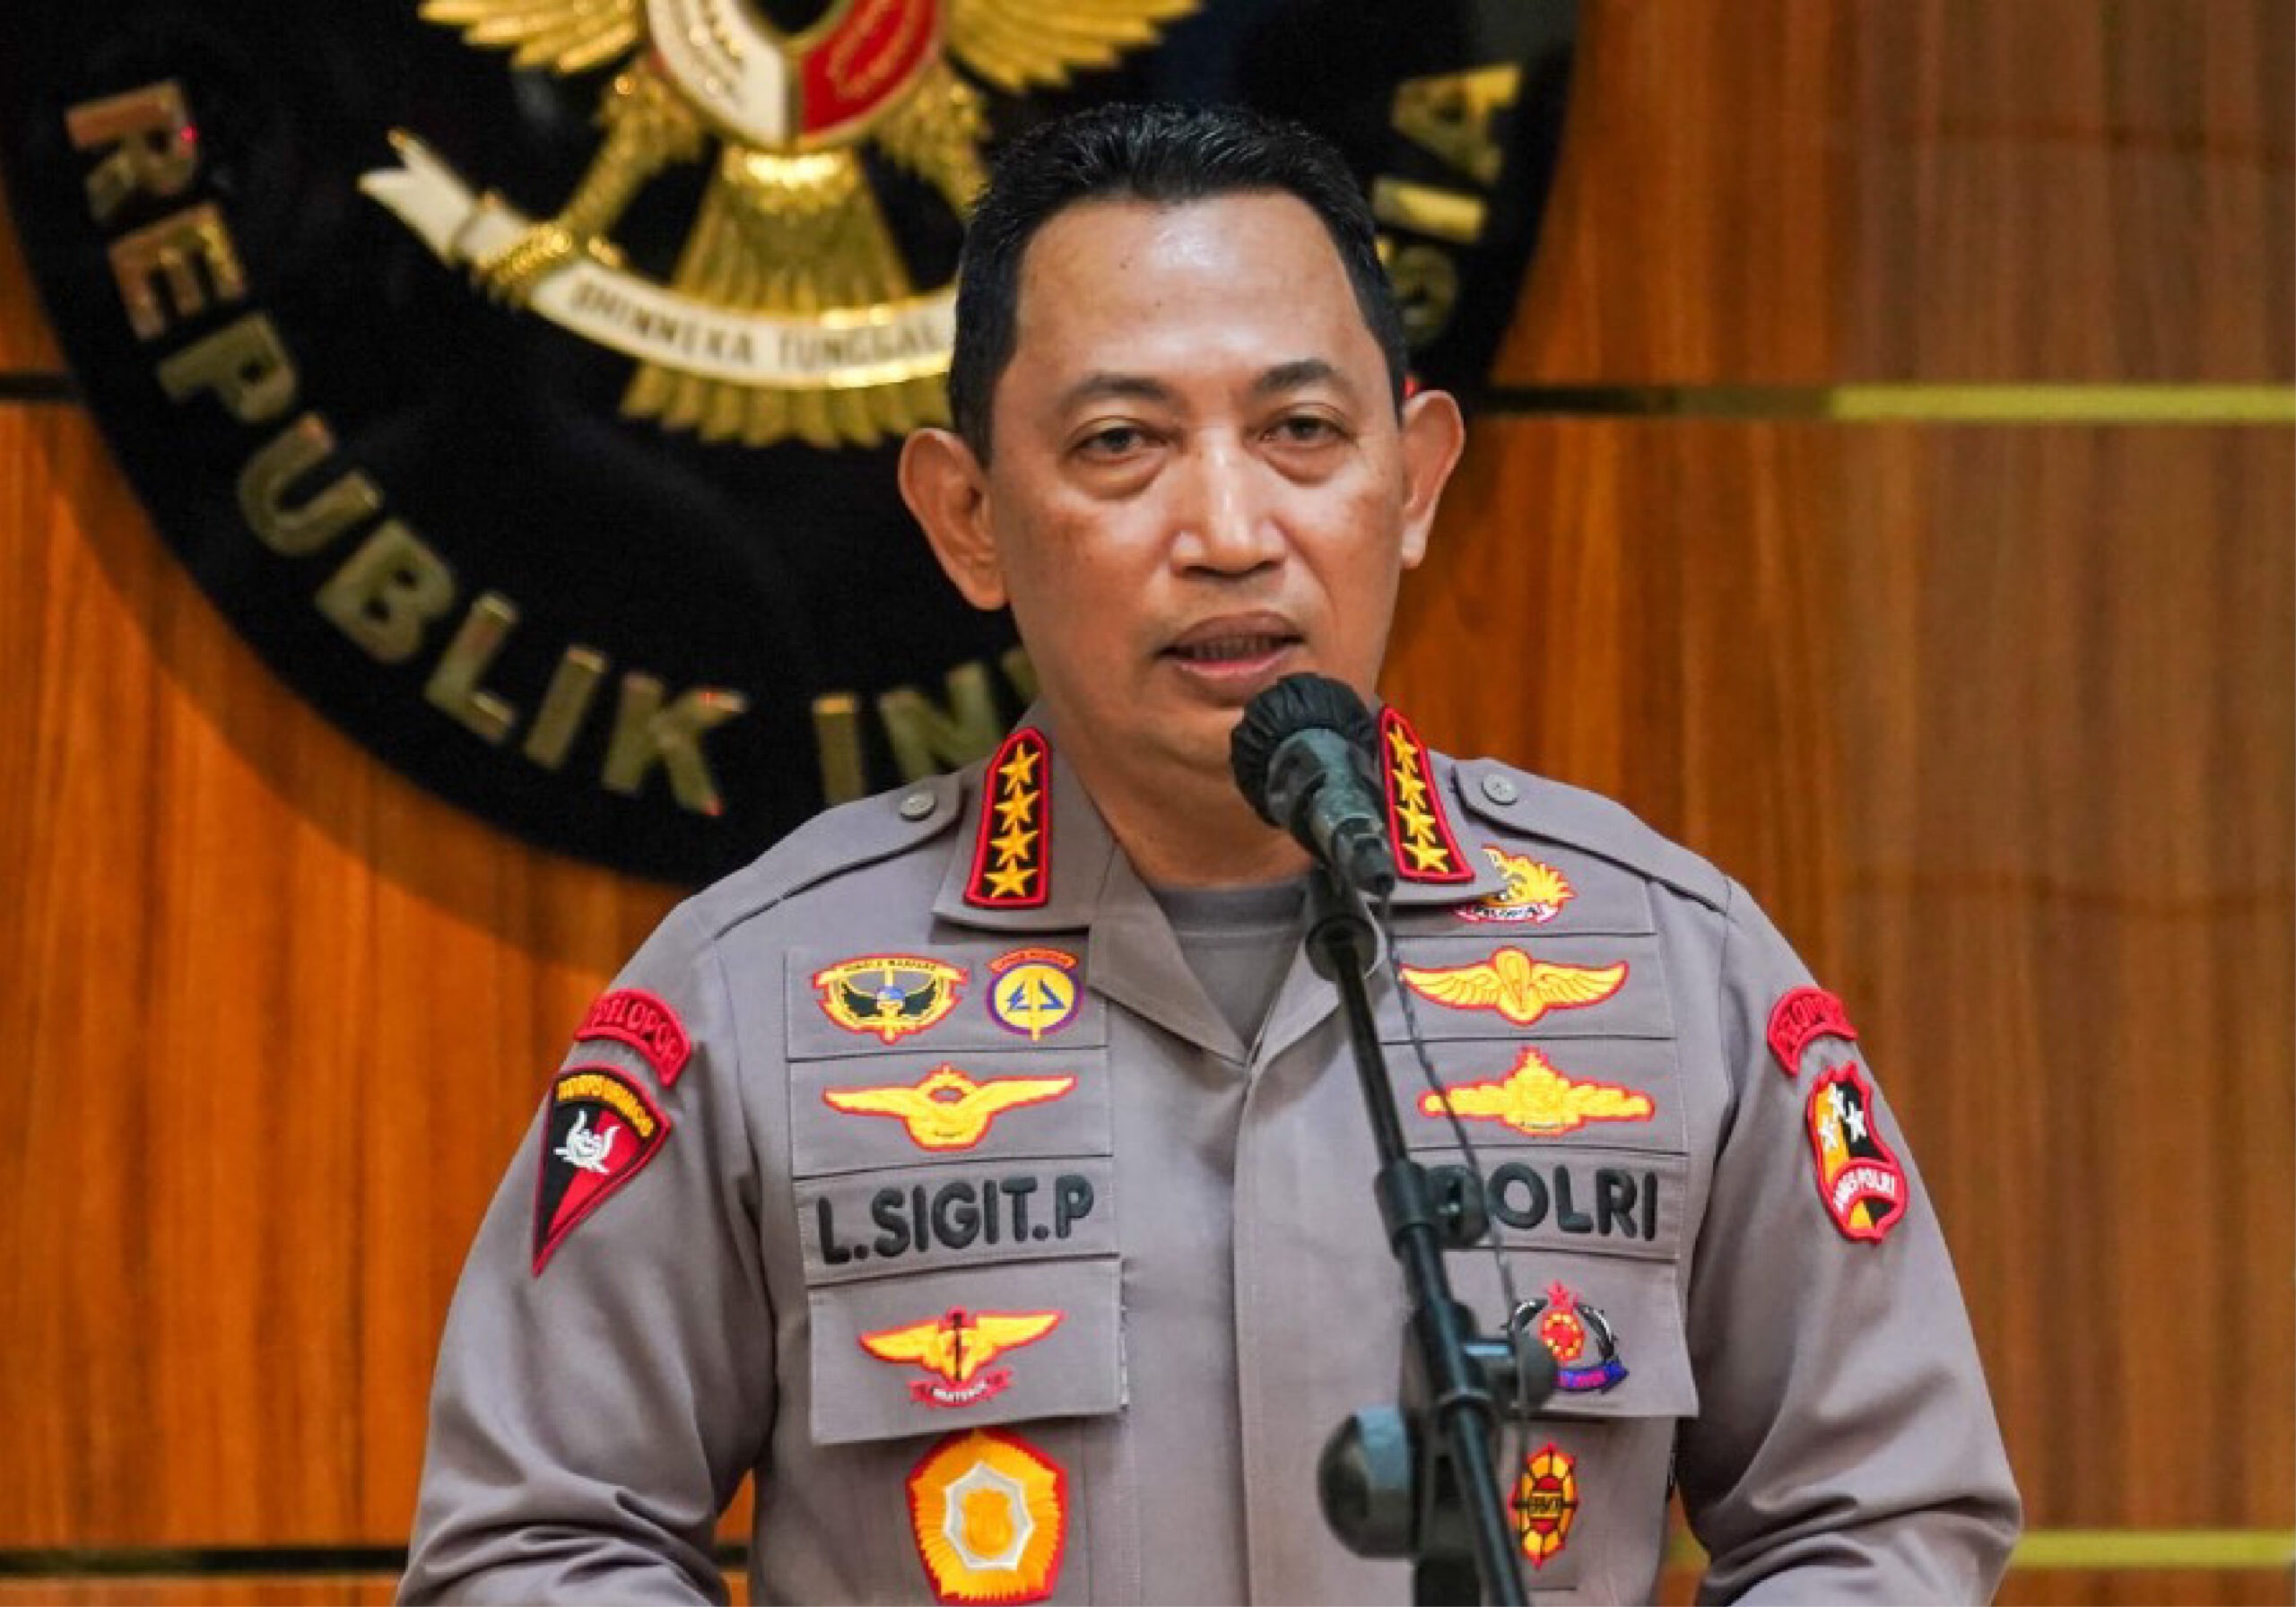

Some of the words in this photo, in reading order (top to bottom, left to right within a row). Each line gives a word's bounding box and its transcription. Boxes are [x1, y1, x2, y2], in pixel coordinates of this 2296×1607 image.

[65, 79, 748, 815] REPUBLIK
[813, 647, 1038, 804] IN
[818, 1174, 1094, 1264] L.SIGIT.P
[1444, 1163, 1657, 1241] OLRI
